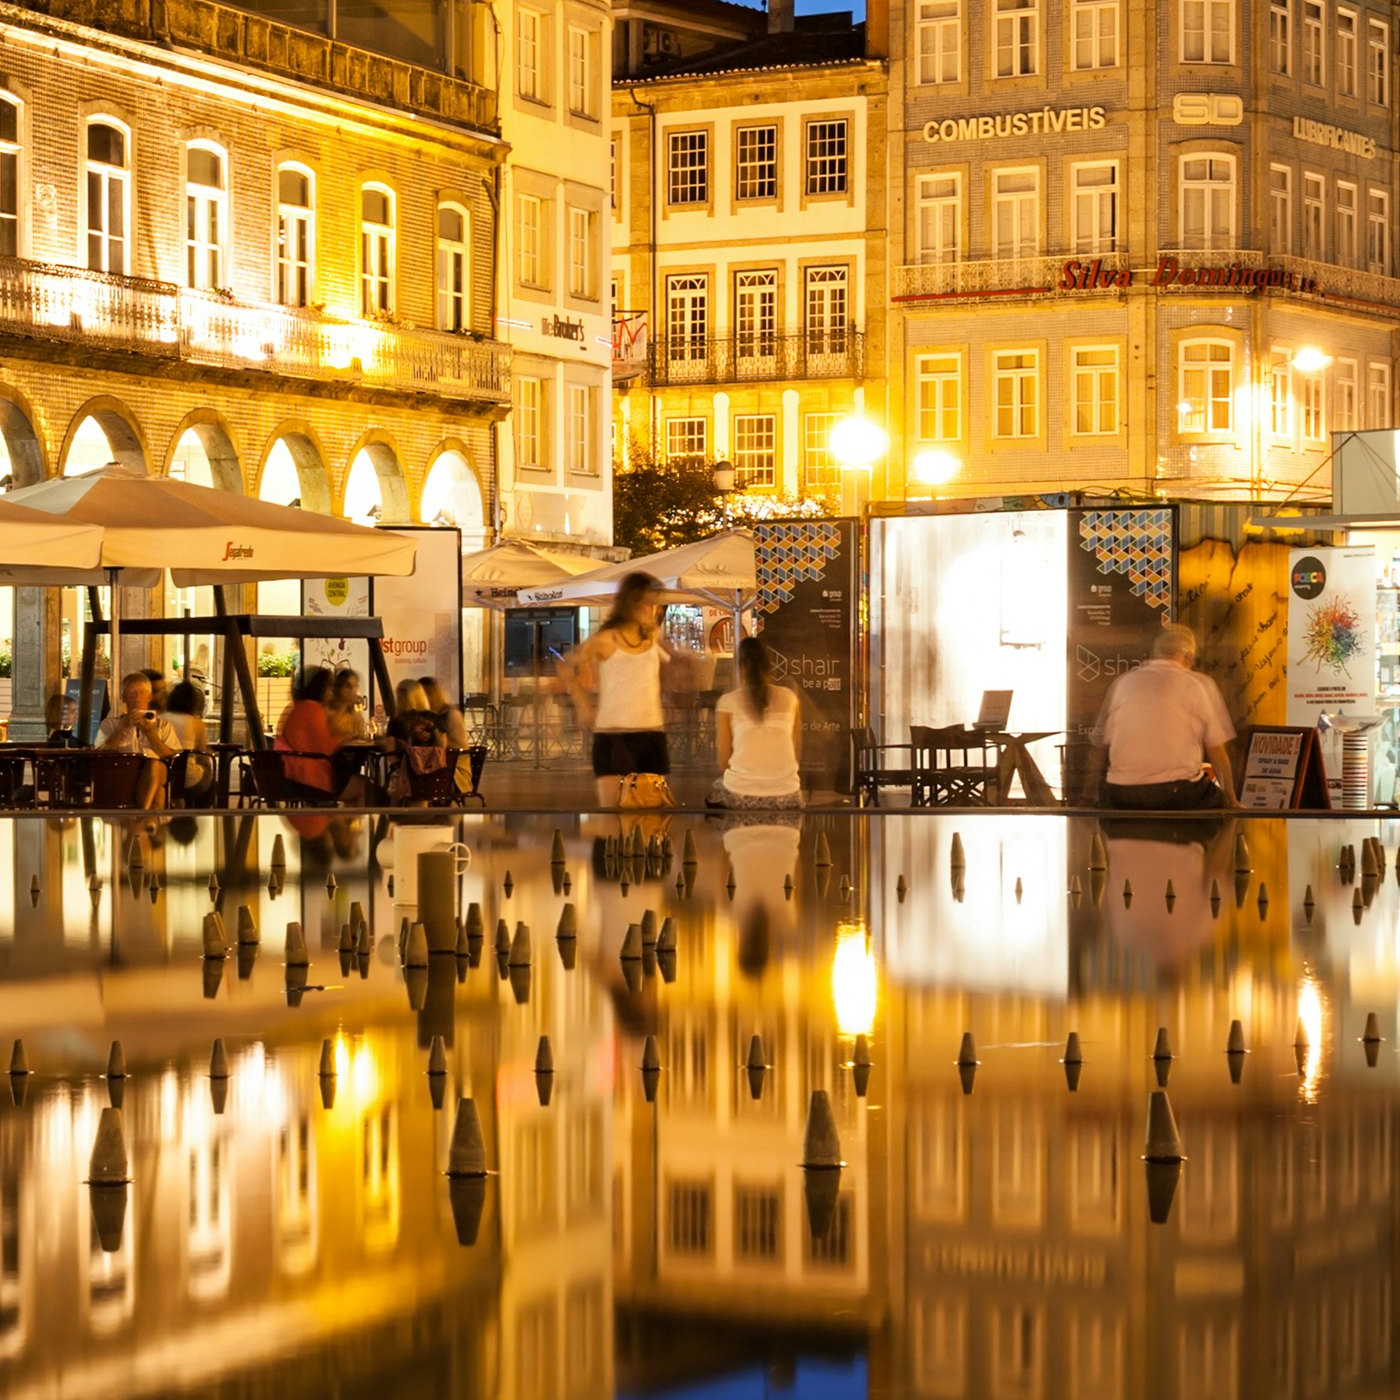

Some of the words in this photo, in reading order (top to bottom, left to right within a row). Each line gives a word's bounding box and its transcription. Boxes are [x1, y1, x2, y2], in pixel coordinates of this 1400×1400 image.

[1173, 92, 1244, 126] SD
[922, 105, 1107, 143] COMBUSTÍVEIS
[1293, 116, 1377, 160] LUBRIFICANTES
[1058, 259, 1134, 290] Silva
[1150, 256, 1298, 294] Domingues
[379, 637, 427, 656] stgroup
[790, 654, 840, 676] shair
[1104, 653, 1147, 676] sha
[802, 678, 813, 689] be
[815, 681, 822, 689] a
[1251, 735, 1293, 755] NOVIDADE
